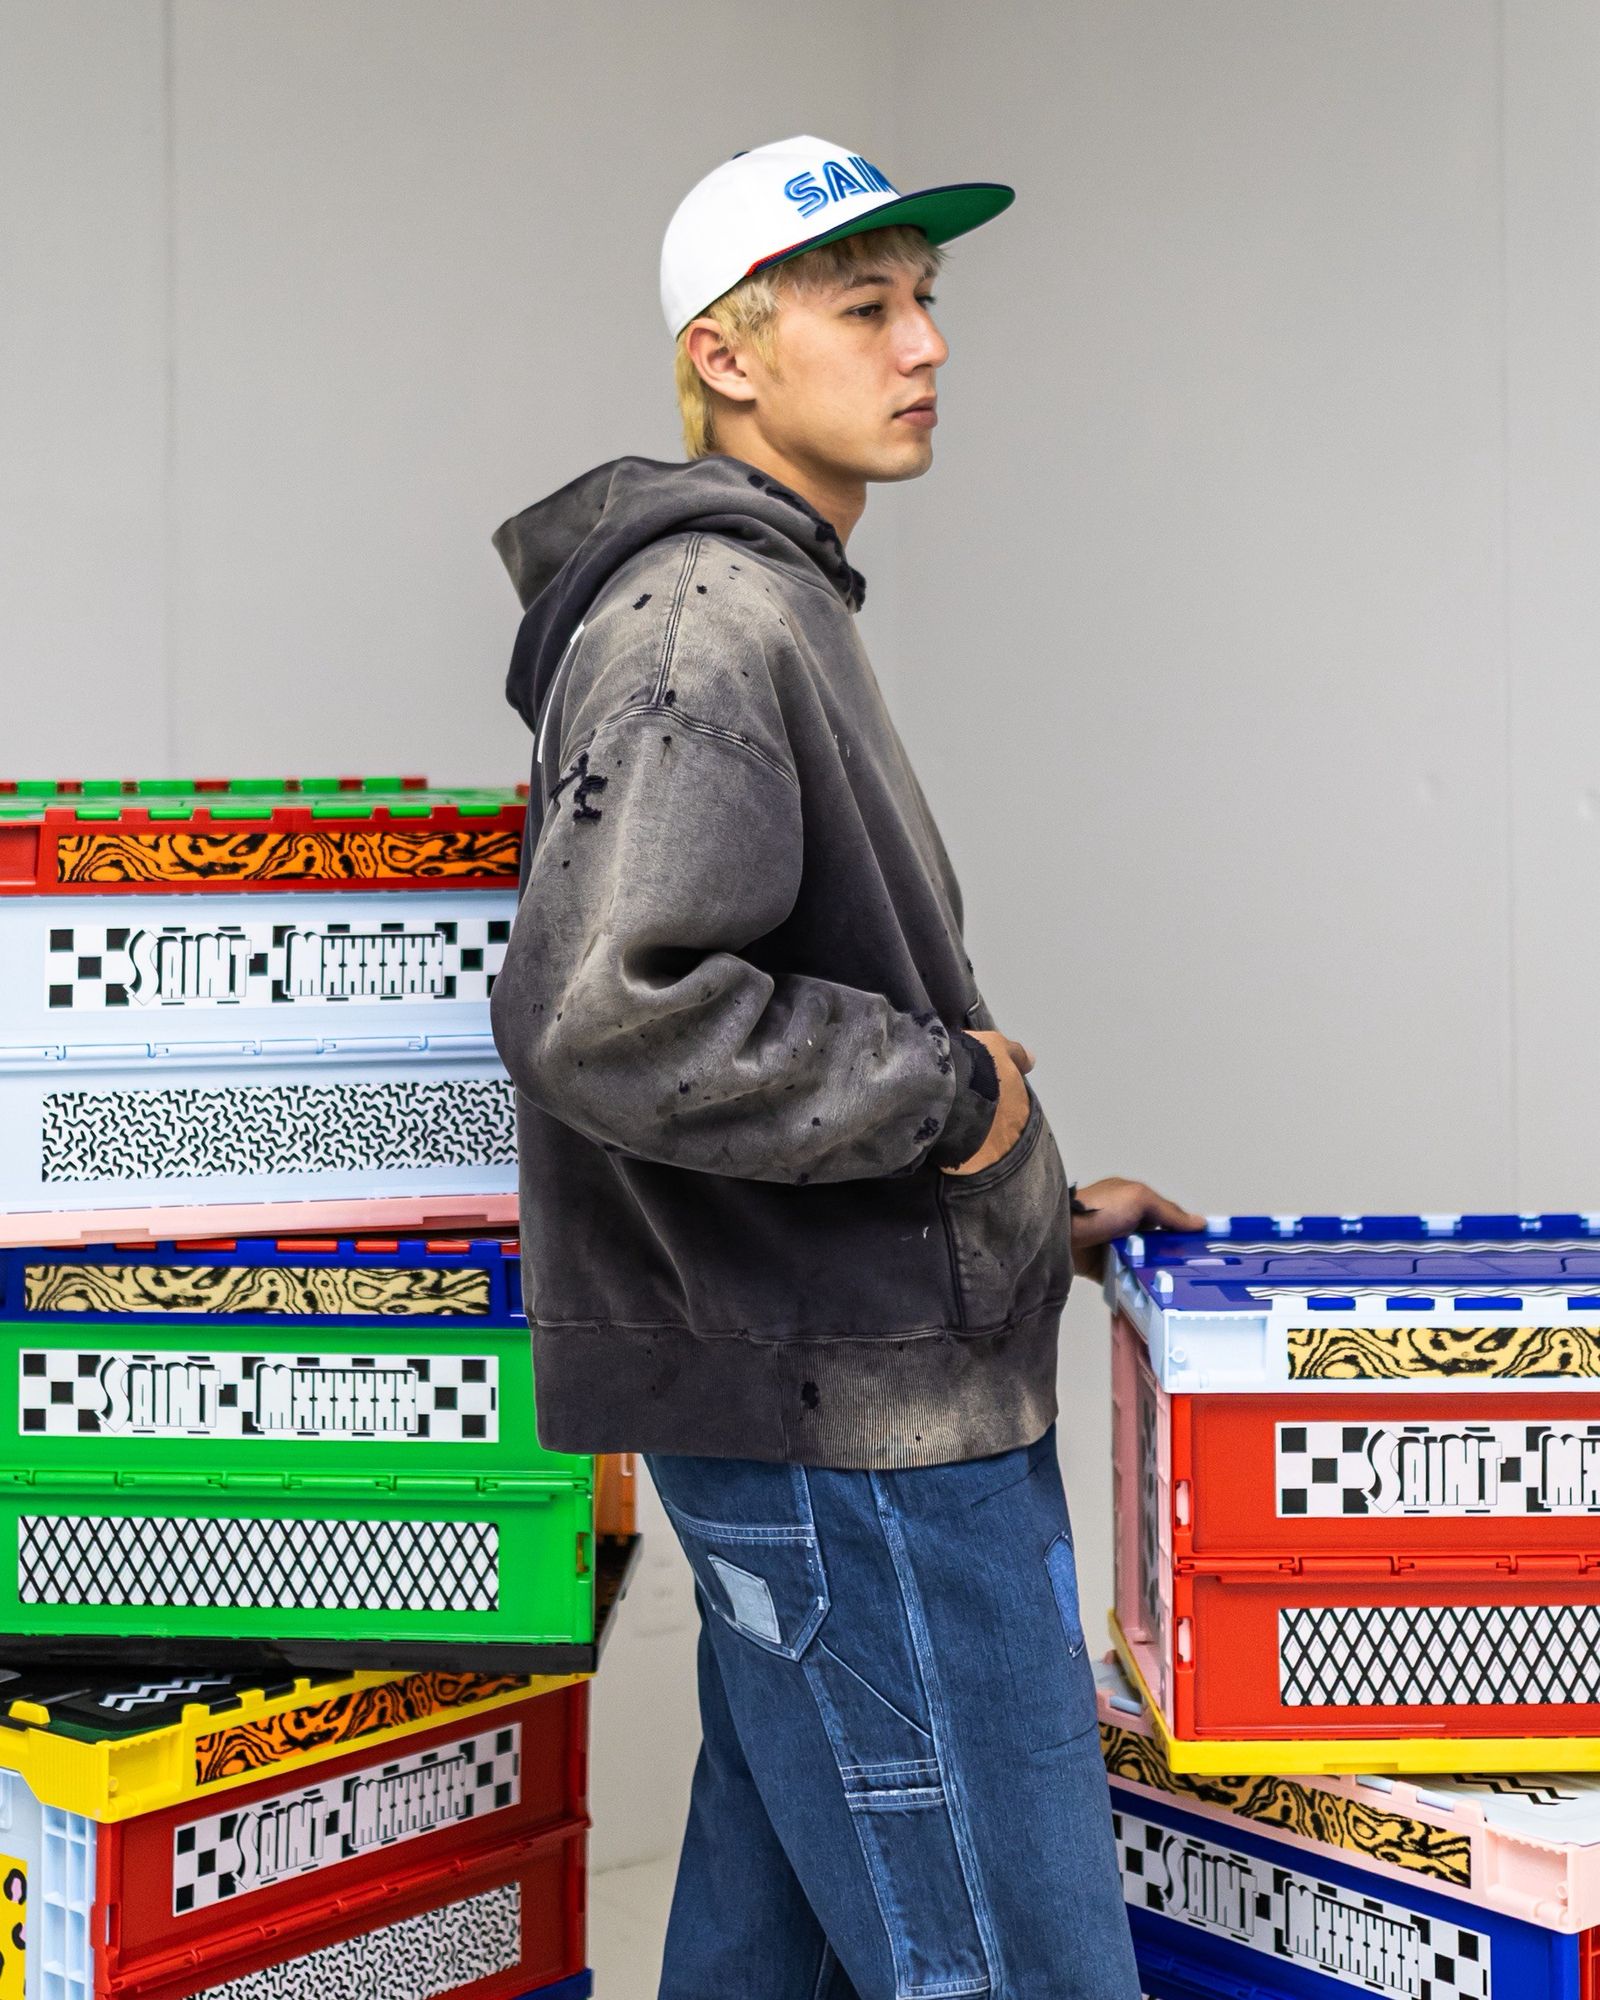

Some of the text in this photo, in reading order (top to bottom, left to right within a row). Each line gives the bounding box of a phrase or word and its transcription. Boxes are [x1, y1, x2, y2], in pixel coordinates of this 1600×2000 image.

[124, 929, 253, 1006] SAINT
[94, 1356, 222, 1432] SAINT
[1361, 1429, 1503, 1513] SAINT
[232, 1796, 329, 1889] SAINT
[1160, 1834, 1258, 1937] SAINT
